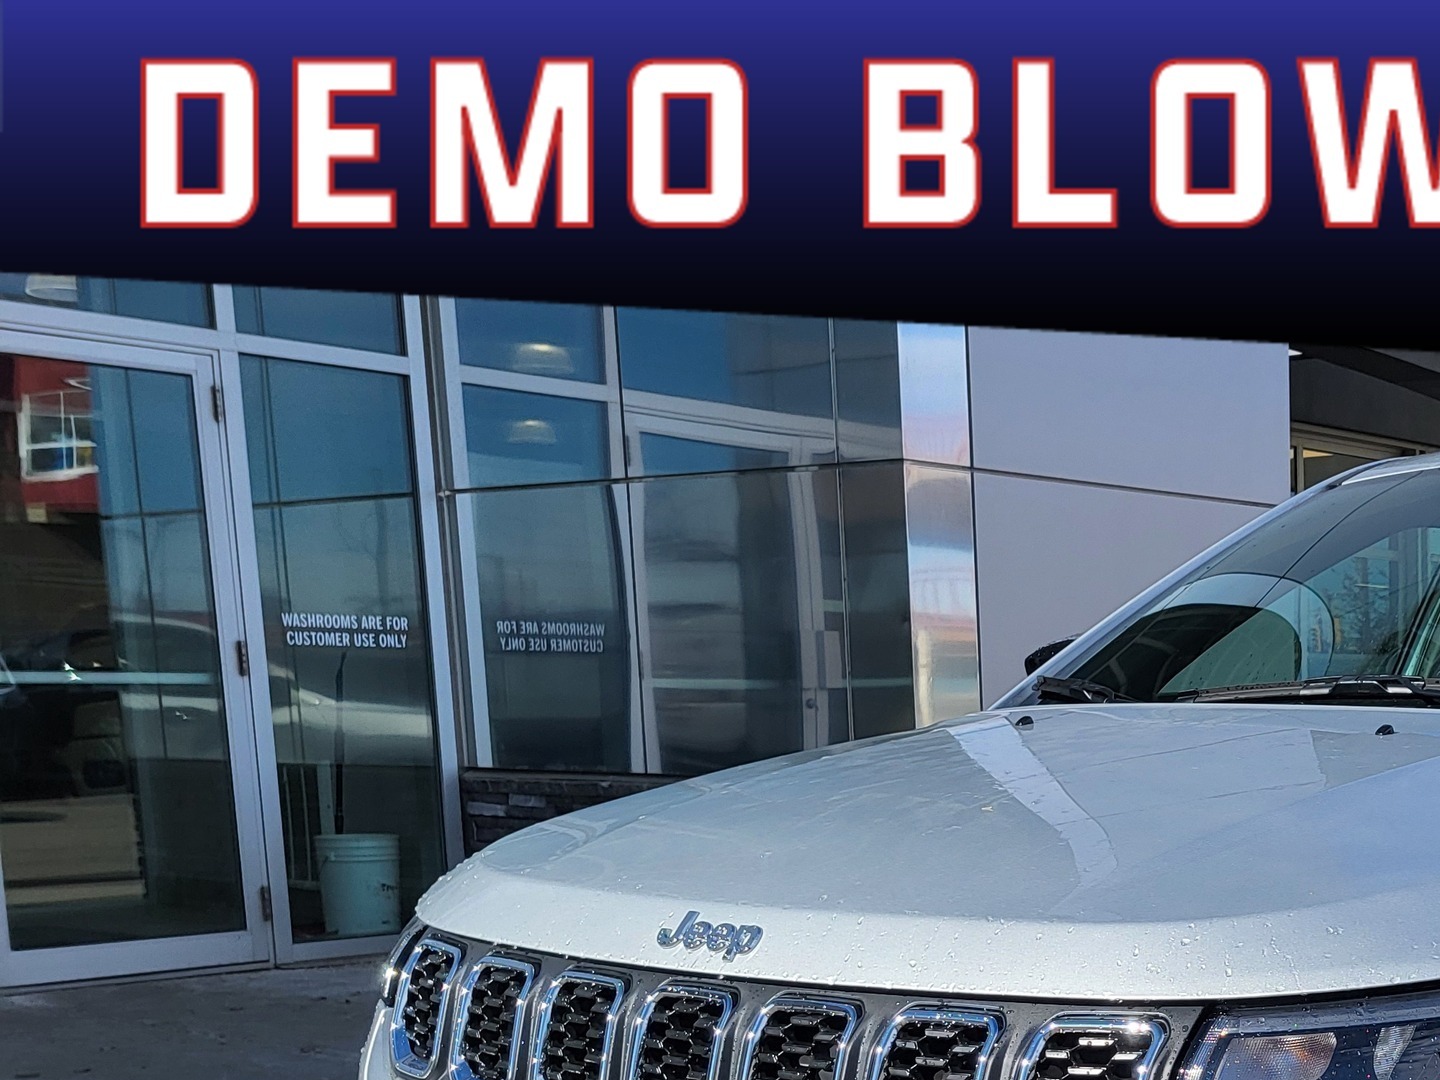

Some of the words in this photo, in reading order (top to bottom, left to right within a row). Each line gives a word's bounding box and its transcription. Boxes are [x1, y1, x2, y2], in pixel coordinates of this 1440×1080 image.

[281, 612, 358, 630] WASHROOMS
[361, 615, 384, 630] ARE
[386, 616, 409, 631] FOR
[286, 631, 350, 647] CUSTOMER
[353, 633, 377, 648] USE
[379, 634, 407, 648] ONLY
[656, 910, 763, 963] Jeep
